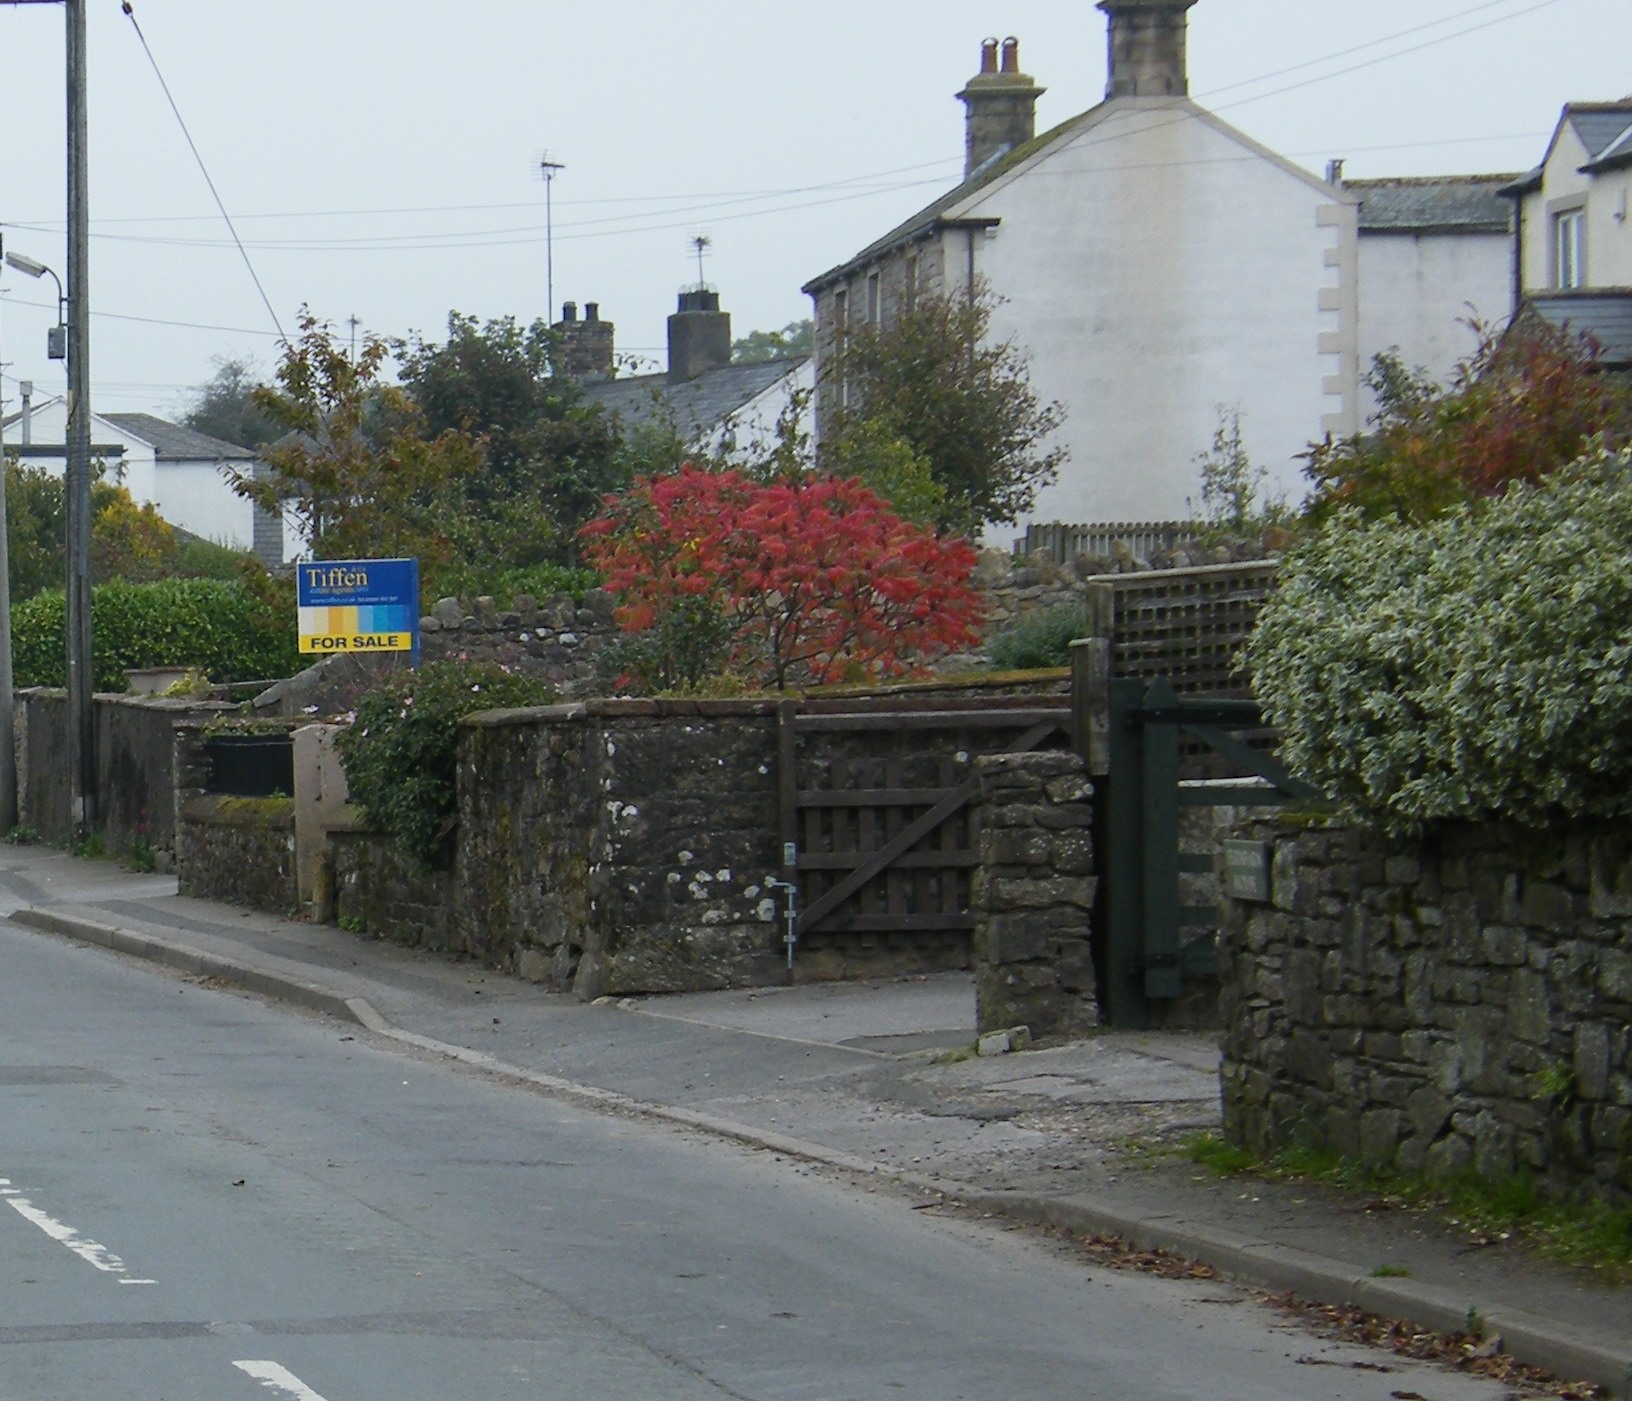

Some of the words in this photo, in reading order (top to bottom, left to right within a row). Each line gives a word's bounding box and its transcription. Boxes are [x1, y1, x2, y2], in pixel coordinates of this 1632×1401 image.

[306, 567, 368, 587] Tiffen
[311, 637, 347, 649] FOR
[353, 636, 399, 648] SALE
